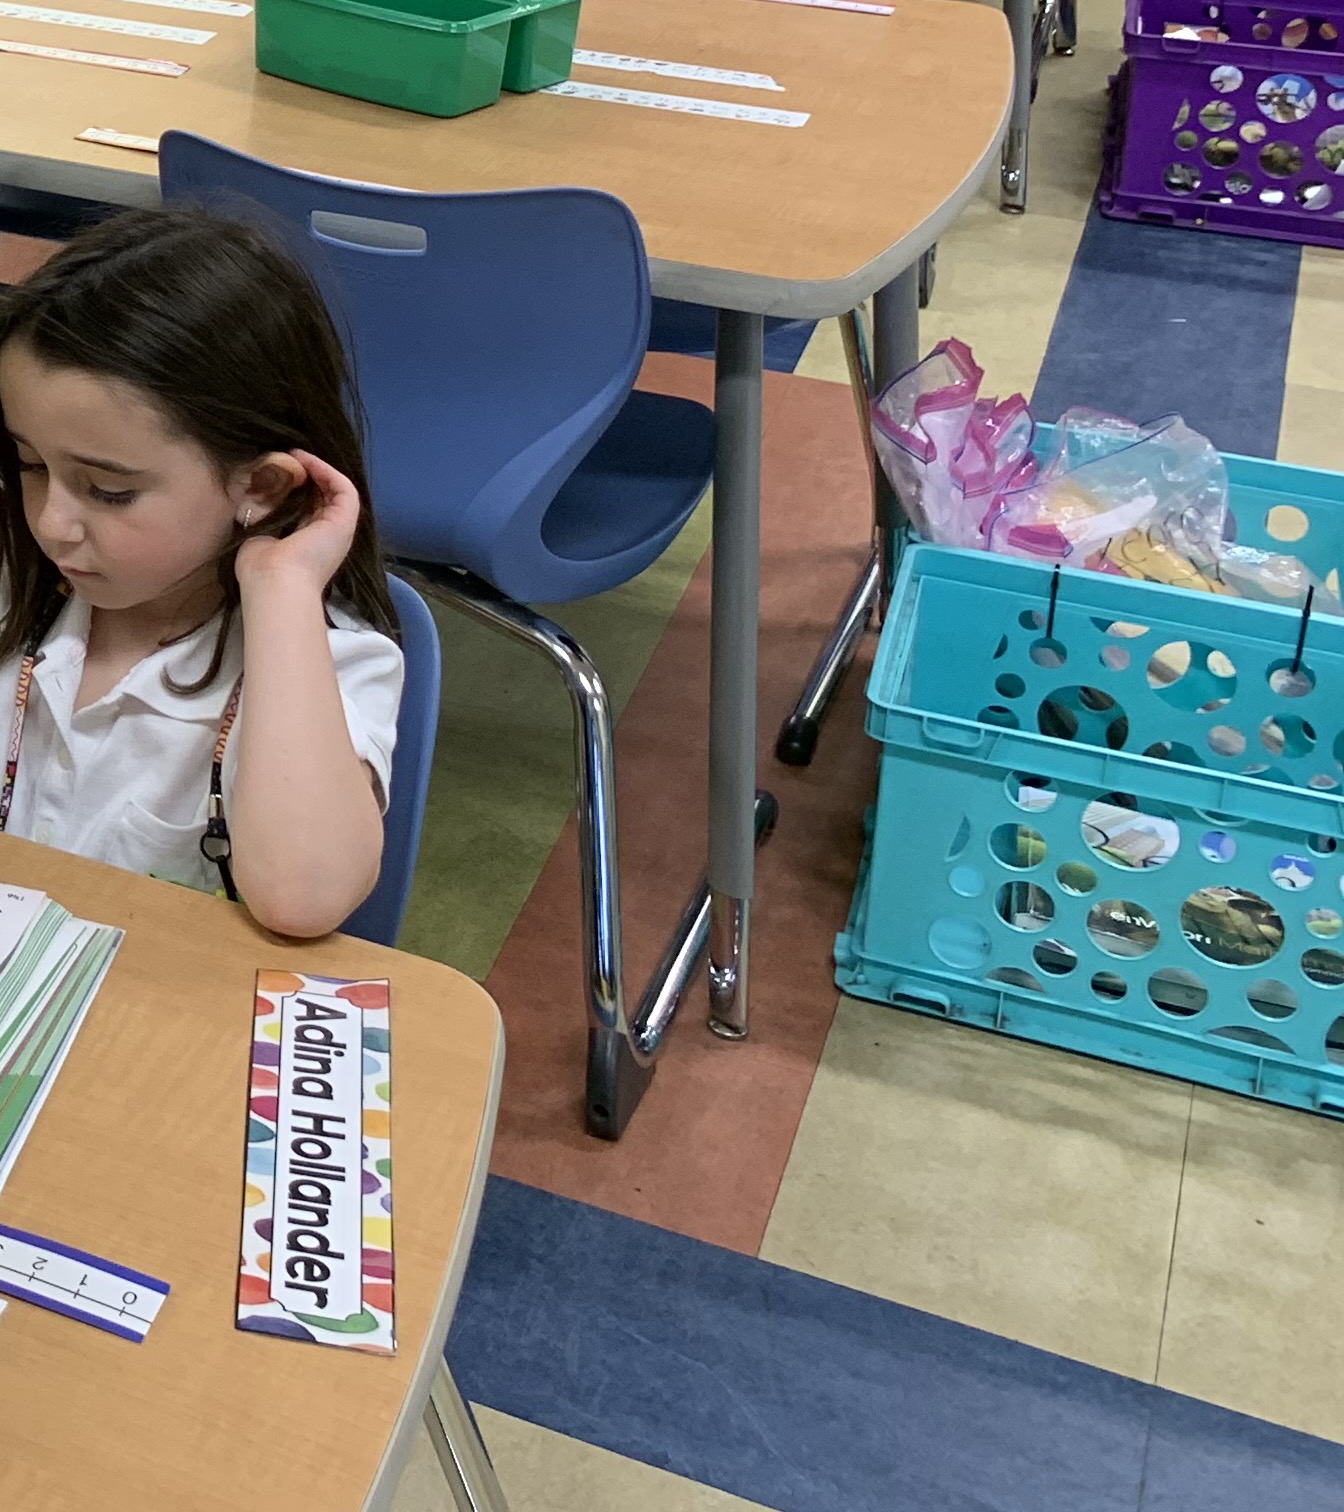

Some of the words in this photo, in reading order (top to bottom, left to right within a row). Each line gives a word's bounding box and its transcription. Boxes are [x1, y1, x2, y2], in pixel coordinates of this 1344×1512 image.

[292, 997, 347, 1100] Adina
[284, 1109, 346, 1310] Hollander
[31, 1256, 48, 1270] 2
[79, 1274, 89, 1285] 1
[122, 1291, 137, 1305] 0
